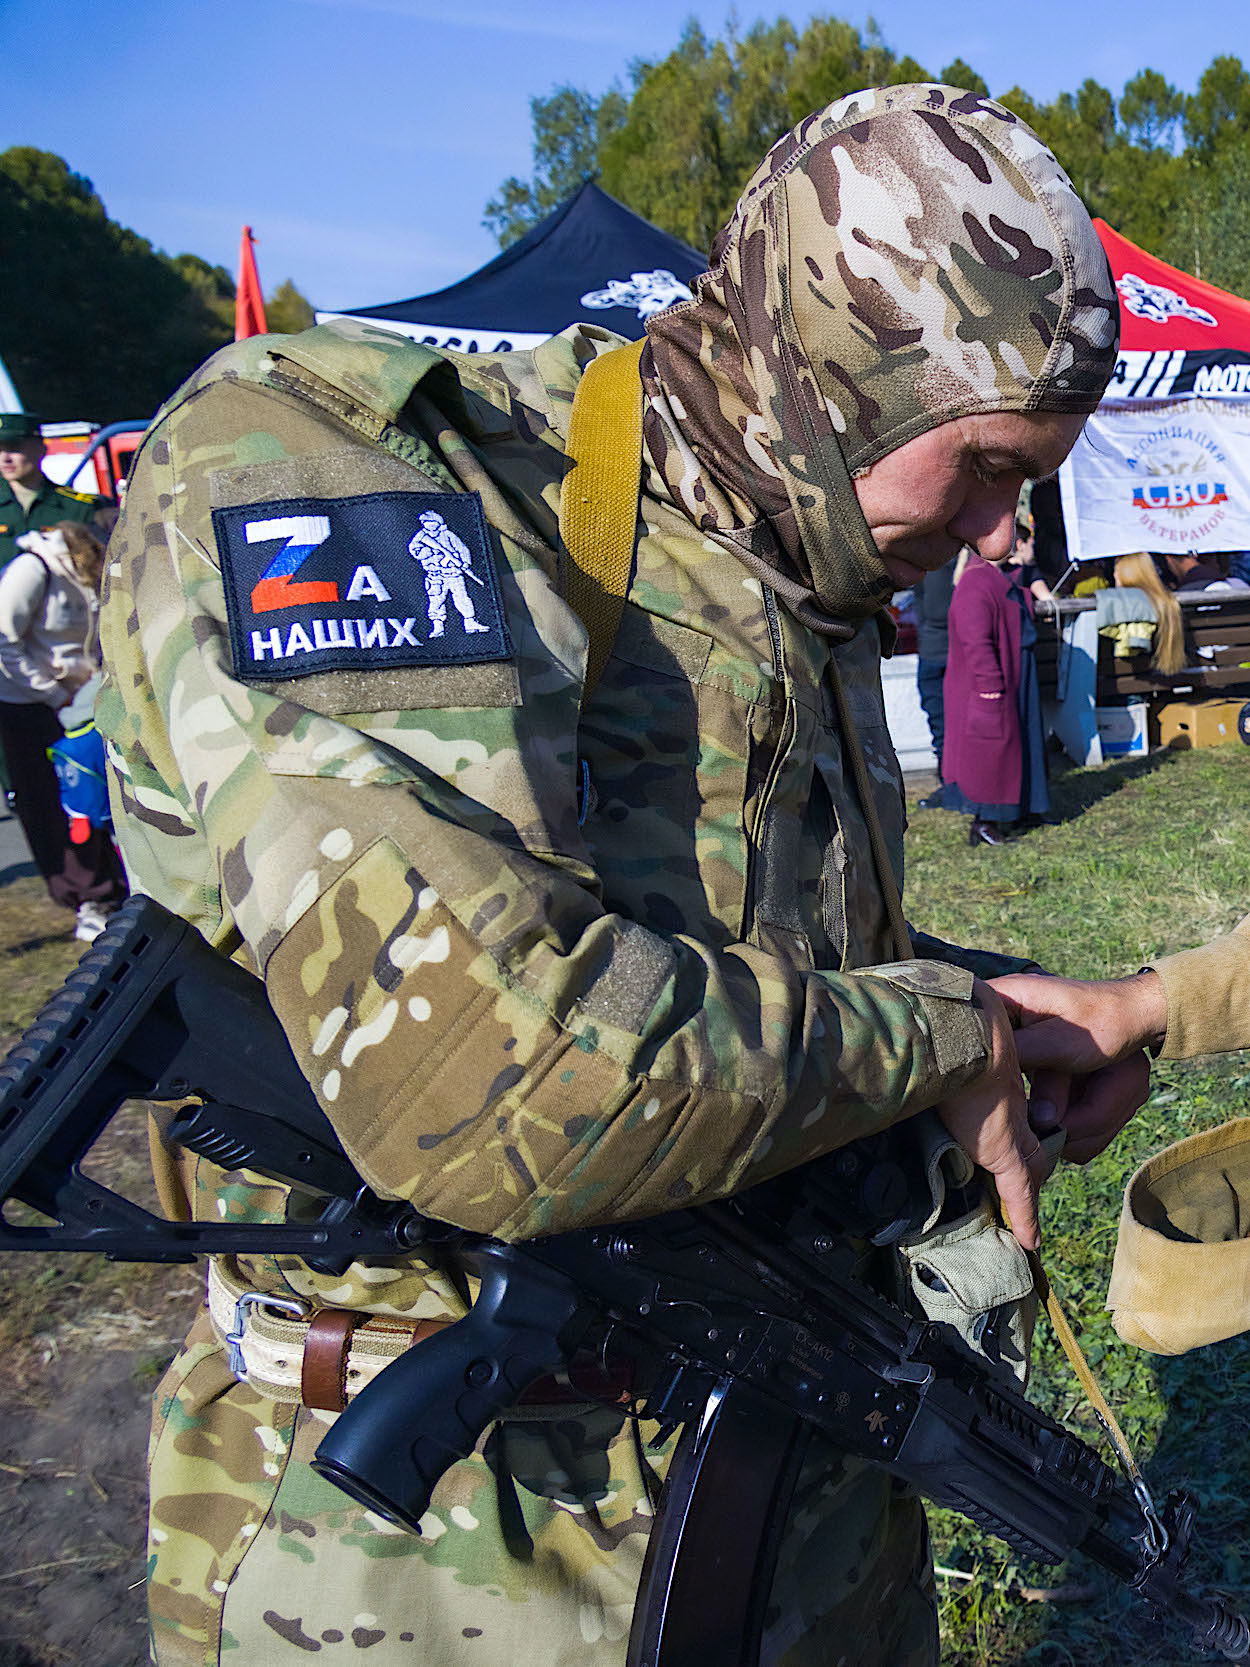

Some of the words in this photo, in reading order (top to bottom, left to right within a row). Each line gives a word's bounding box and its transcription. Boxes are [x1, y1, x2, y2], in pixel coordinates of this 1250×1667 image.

[1127, 425, 1226, 469] АССОЦИАЦИЯ
[1142, 478, 1216, 507] СВО
[1139, 508, 1226, 542] ВЕТЕРАНОВ
[250, 616, 425, 662] НАШИХ
